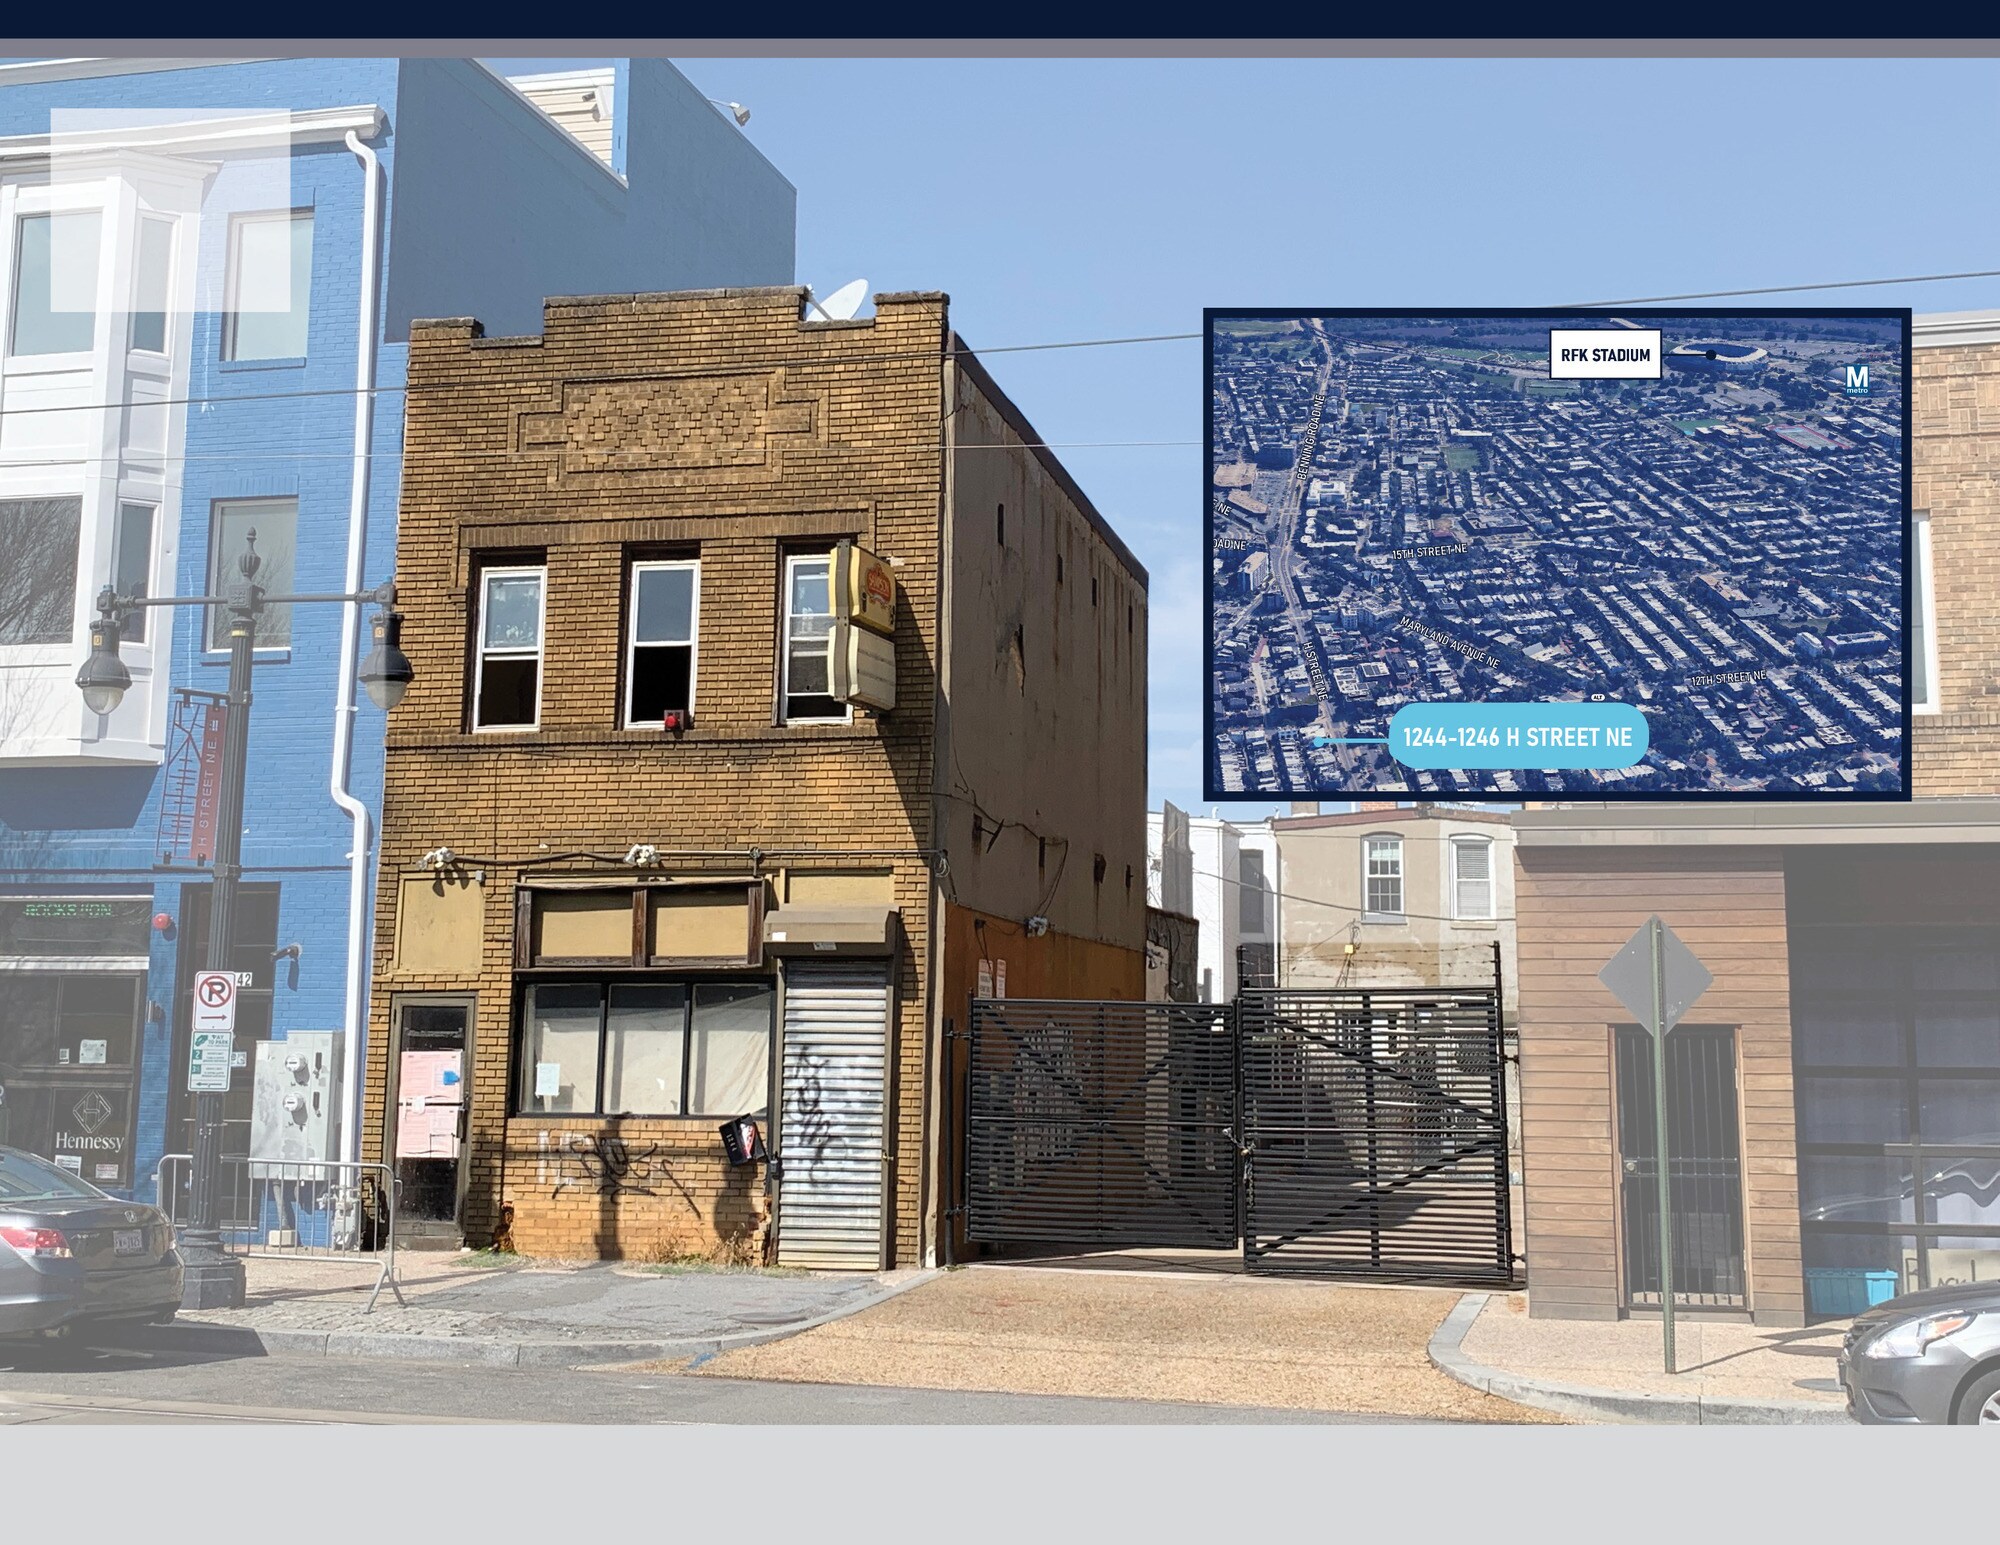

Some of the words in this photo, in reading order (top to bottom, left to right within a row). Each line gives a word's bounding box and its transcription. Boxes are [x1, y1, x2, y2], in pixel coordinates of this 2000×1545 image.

[206, 741, 217, 763] NE
[200, 770, 214, 829] STREET
[55, 1131, 125, 1153] Hennessy
